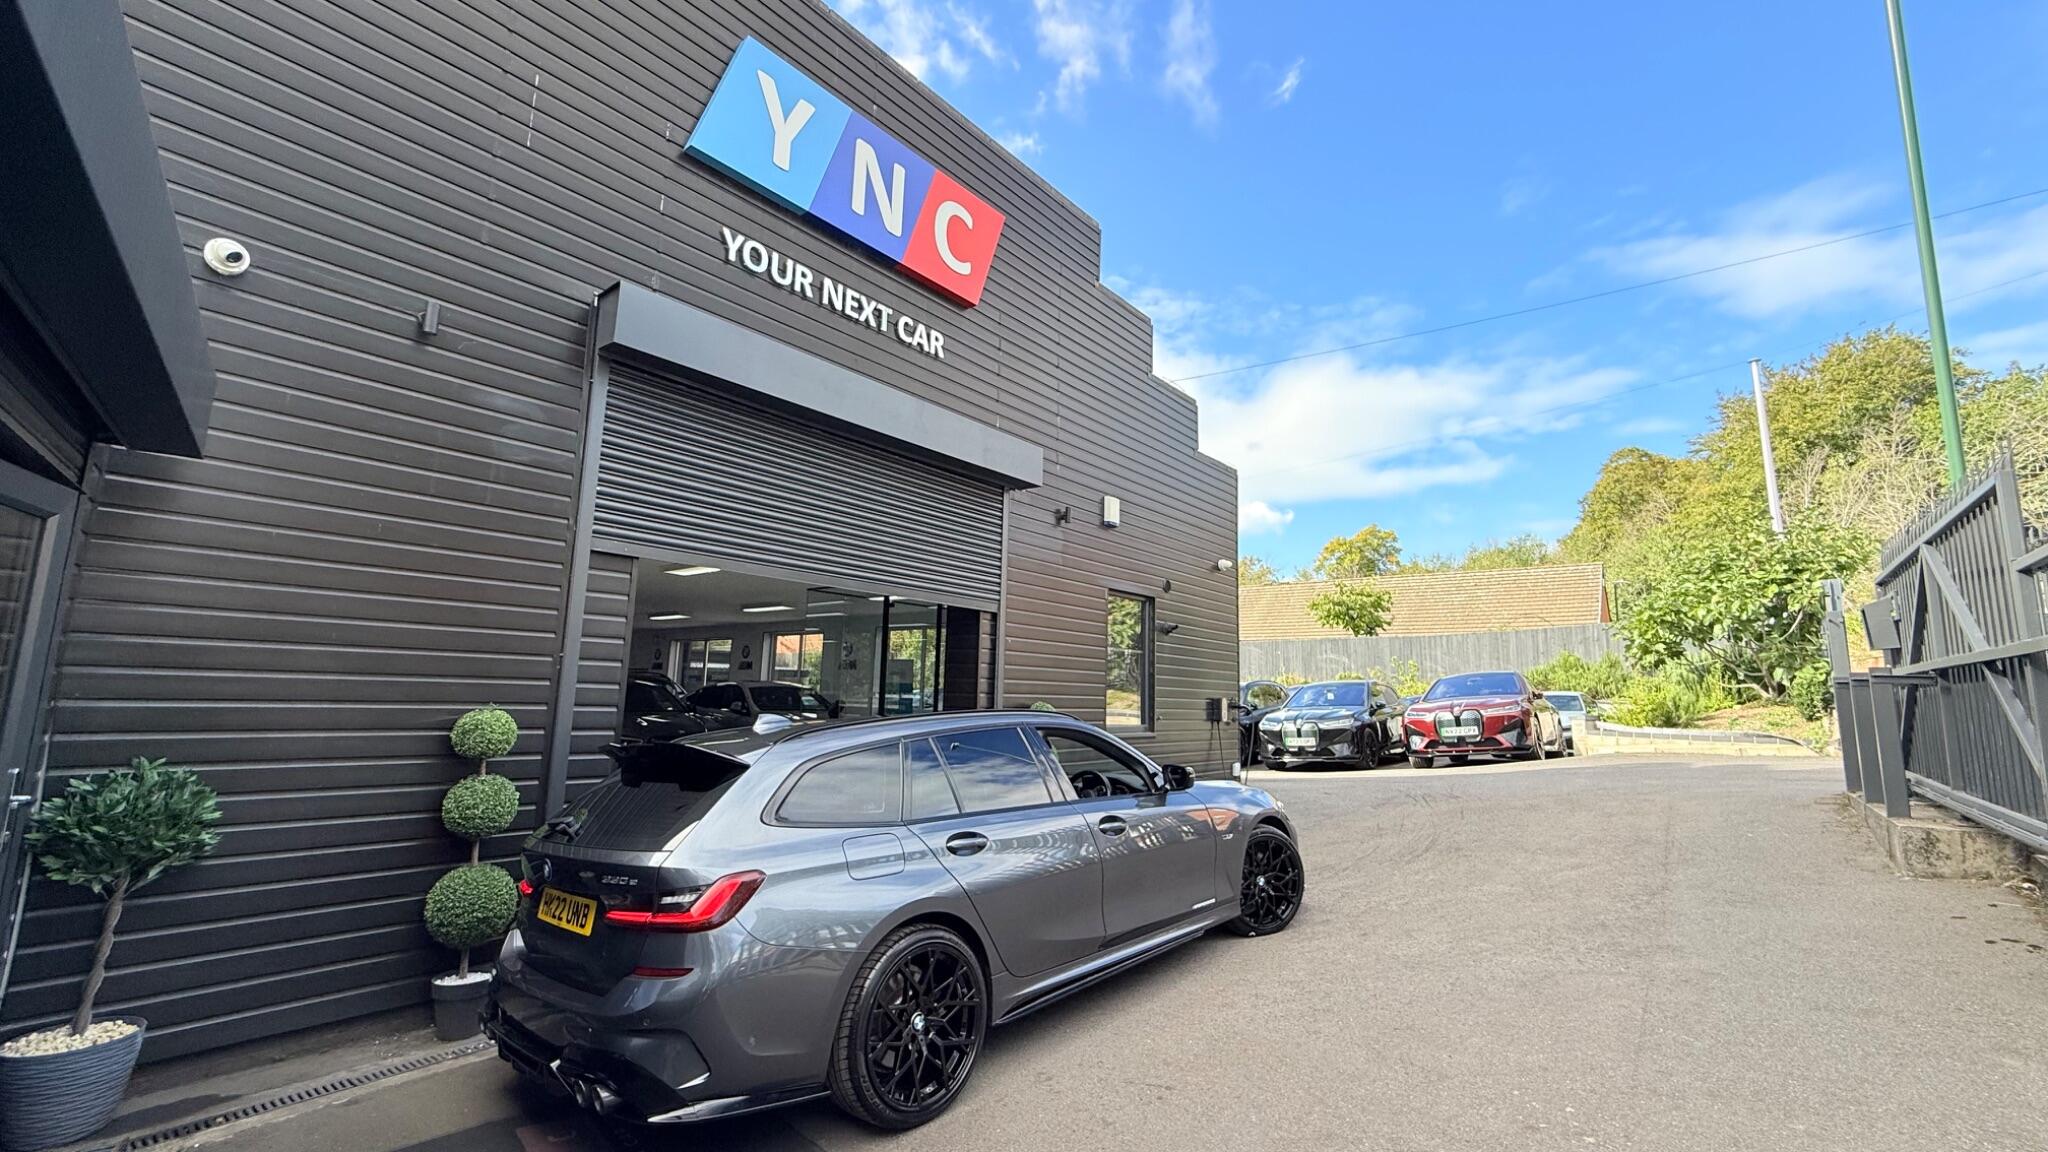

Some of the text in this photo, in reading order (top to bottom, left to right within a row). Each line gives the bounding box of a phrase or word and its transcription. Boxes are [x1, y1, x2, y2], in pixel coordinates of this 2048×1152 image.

[757, 69, 973, 275] YNC
[722, 227, 946, 359] YOUR NEXT CAR
[566, 899, 590, 929] UNB
